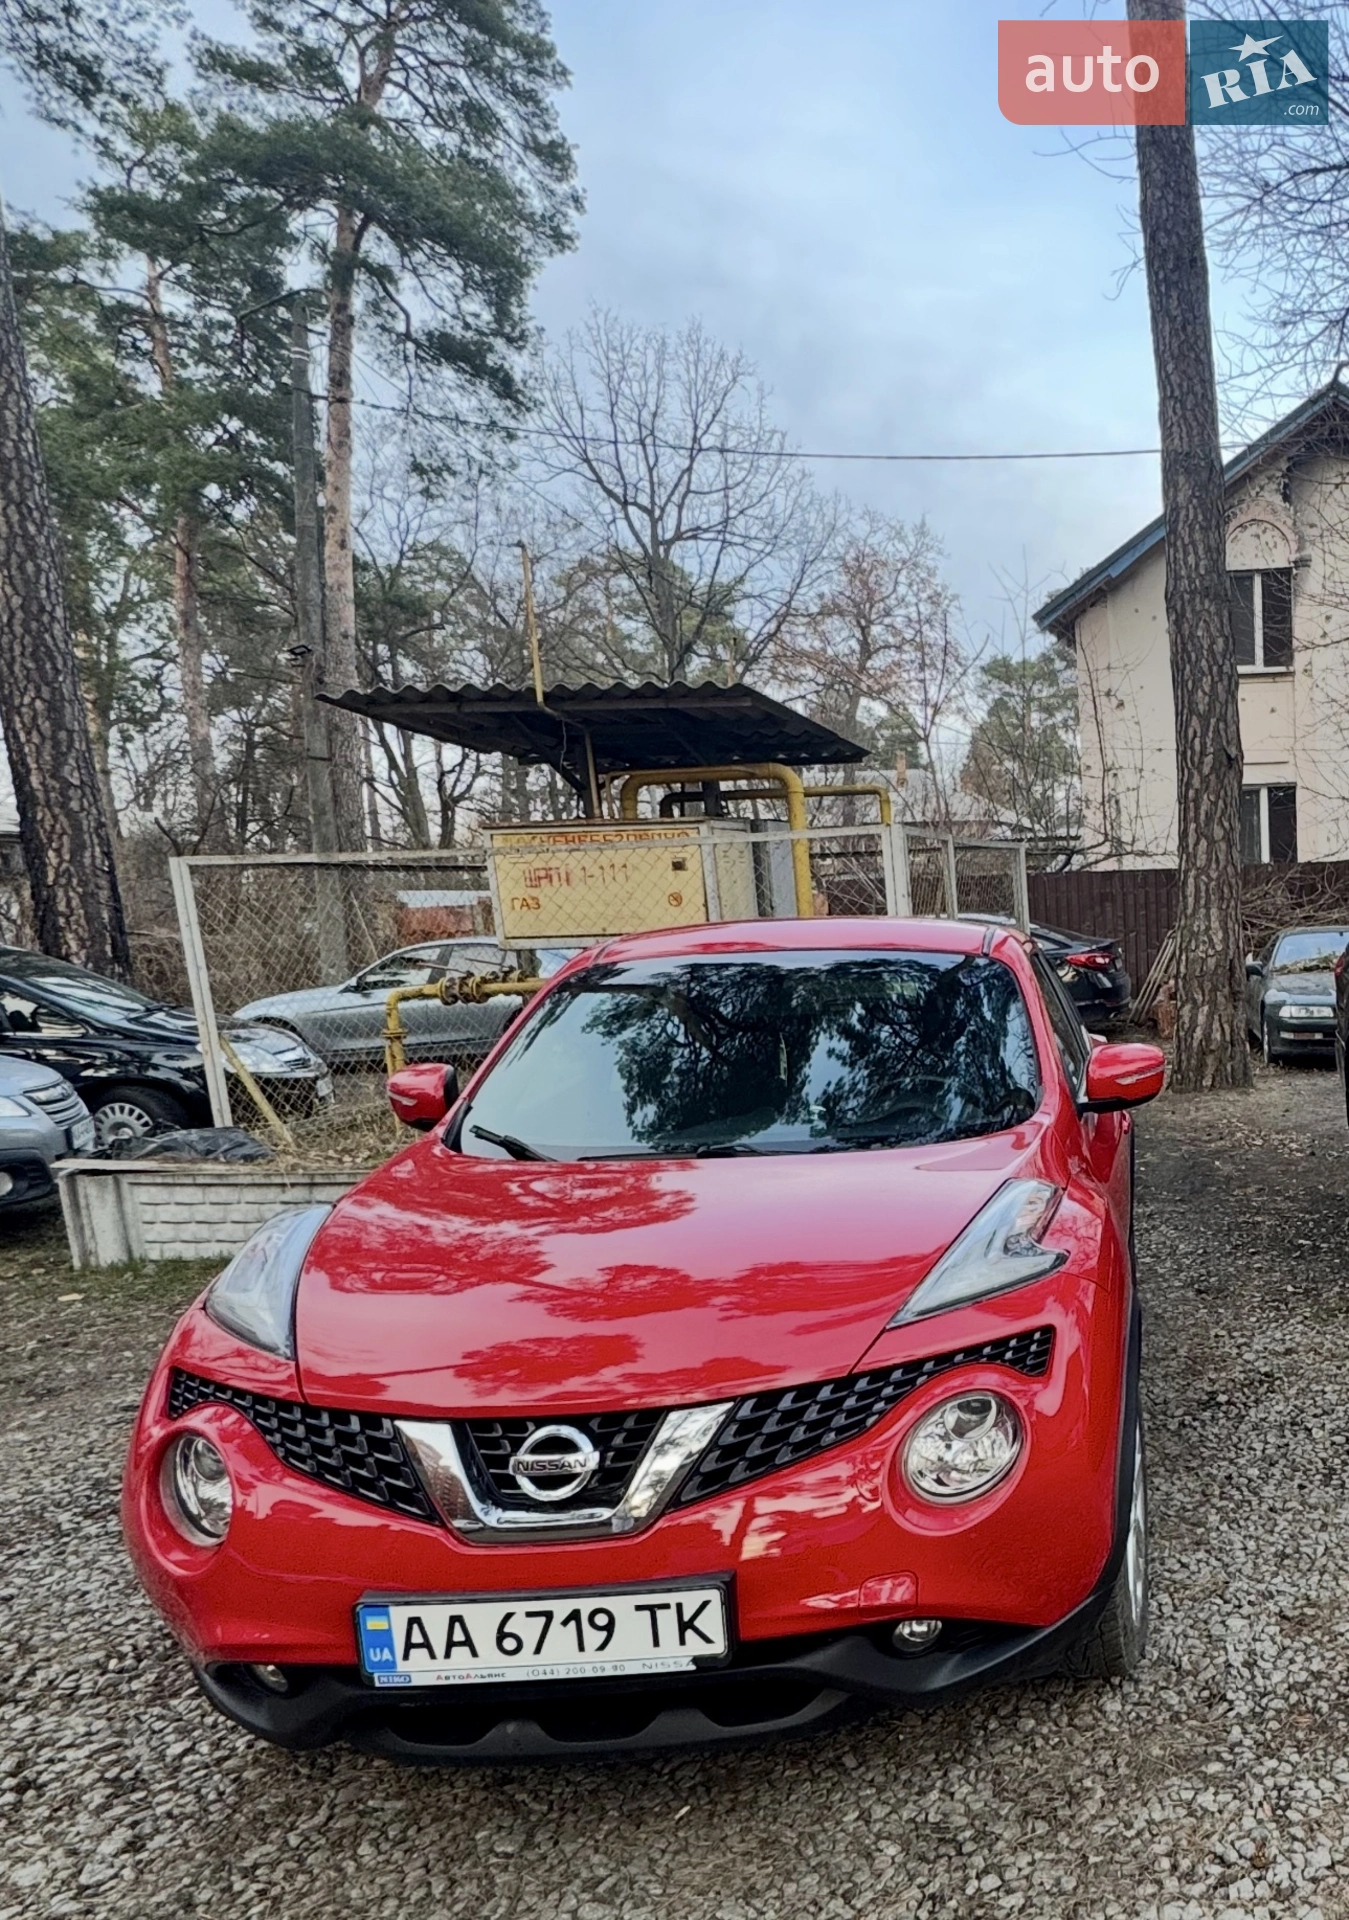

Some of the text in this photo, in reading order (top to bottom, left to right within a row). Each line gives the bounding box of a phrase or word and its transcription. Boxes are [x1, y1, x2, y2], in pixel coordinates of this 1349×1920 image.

[511, 895, 541, 910] ГАЗ
[517, 1459, 586, 1471] NISSAN
[402, 1600, 716, 1660] AA 6719 TK
[370, 1647, 393, 1663] UA
[379, 1675, 410, 1684] NIKO
